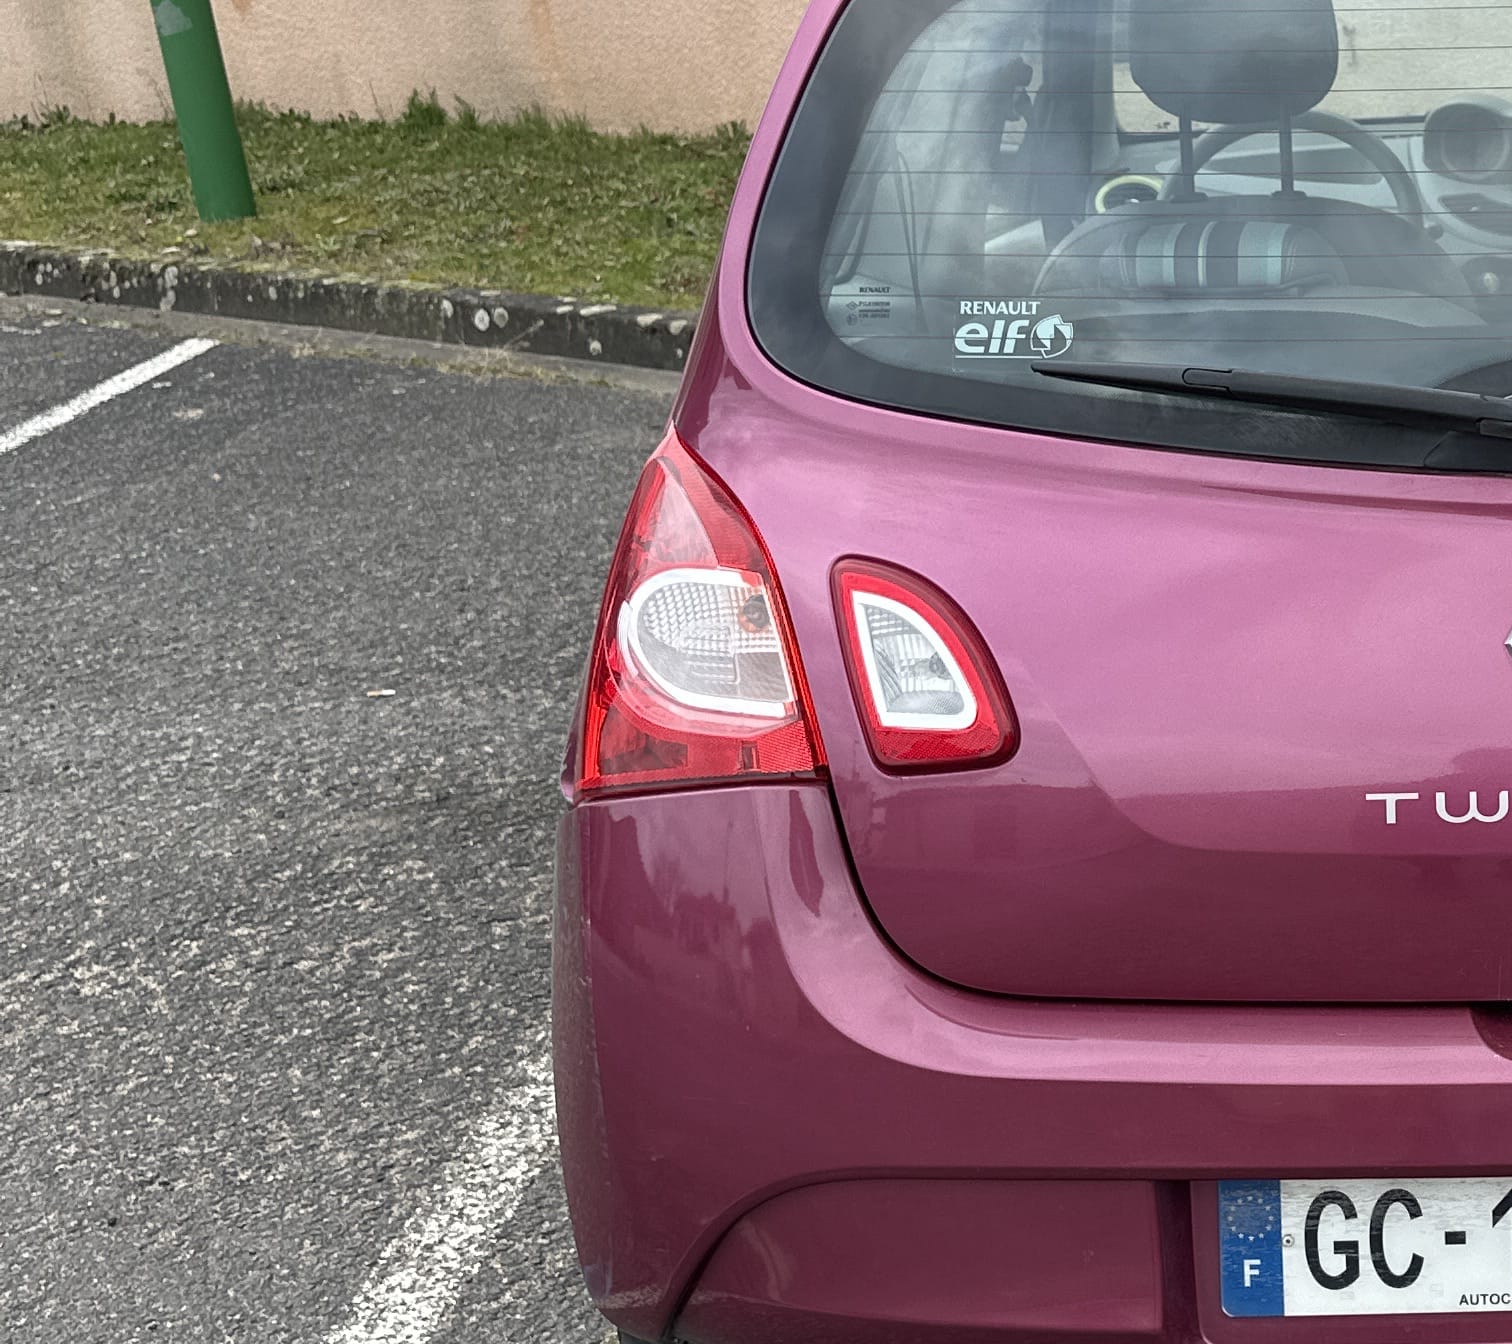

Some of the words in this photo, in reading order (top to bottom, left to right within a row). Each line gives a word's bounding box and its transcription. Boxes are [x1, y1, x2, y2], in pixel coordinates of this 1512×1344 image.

[959, 300, 1041, 315] RENAULT
[954, 319, 1030, 354] elf
[1243, 1258, 1262, 1287] F
